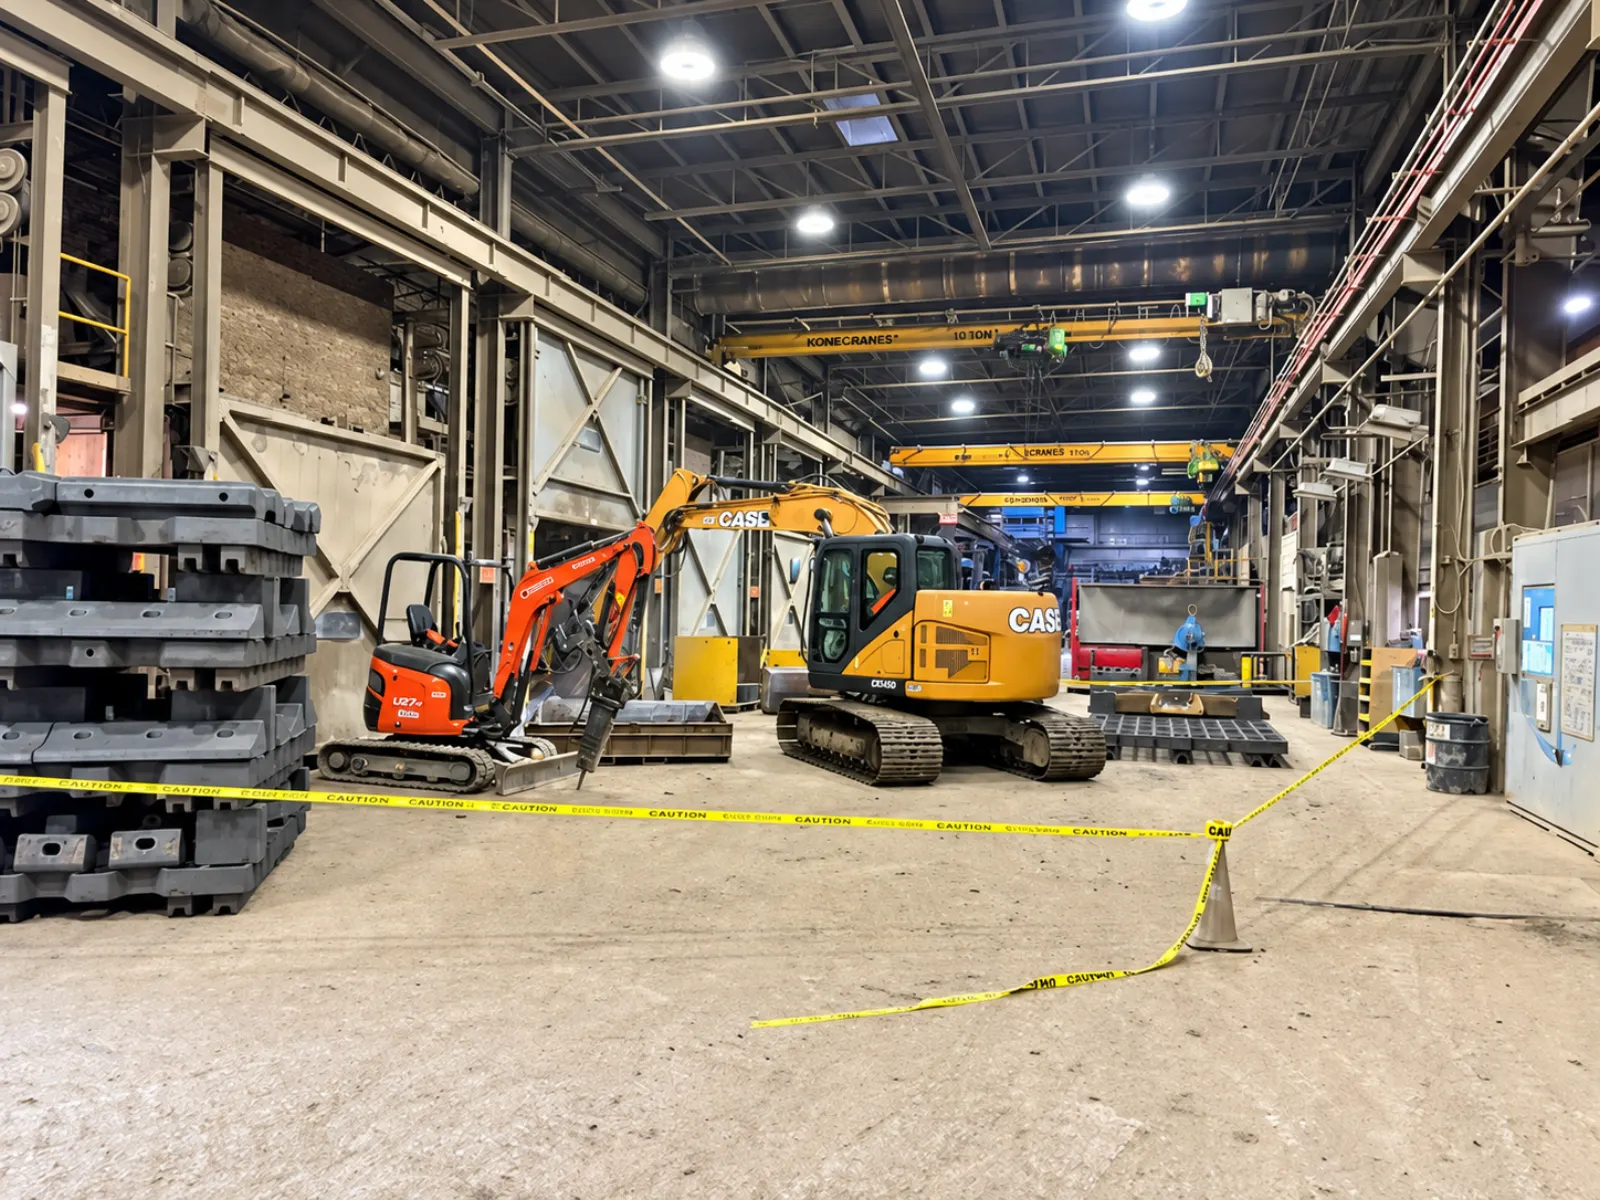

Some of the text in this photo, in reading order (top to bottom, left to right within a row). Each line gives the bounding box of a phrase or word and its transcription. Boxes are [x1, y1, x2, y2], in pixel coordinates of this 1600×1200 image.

[807, 335, 893, 347] KONECRANES
[954, 331, 967, 340] 10
[718, 510, 770, 528] CASE
[1008, 607, 1062, 633] CASE
[59, 780, 123, 790] CAUTION
[162, 786, 221, 795] CAUTION
[326, 794, 390, 804] CAUTION
[409, 799, 464, 808] CAUTION
[502, 804, 557, 813] CAUTION
[649, 810, 707, 819] CAUTION
[795, 816, 851, 825] CAUTION
[936, 822, 991, 831] CAUTION
[1073, 829, 1127, 837] CAUTION
